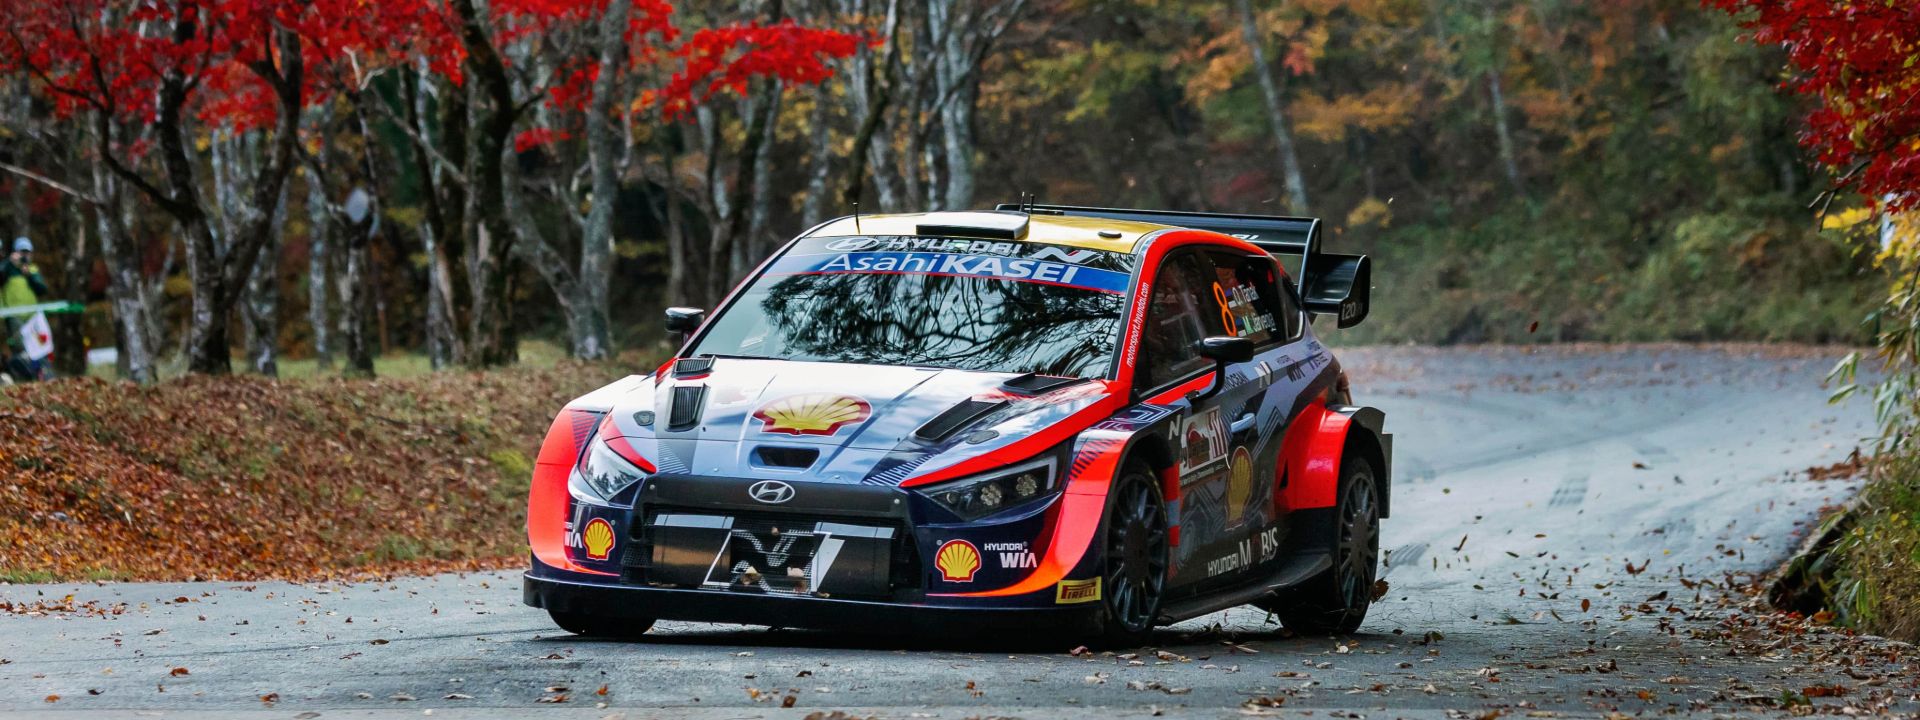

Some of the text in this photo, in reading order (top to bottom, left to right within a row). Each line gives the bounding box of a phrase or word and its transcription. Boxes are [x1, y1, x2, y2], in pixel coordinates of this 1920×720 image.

[1213, 281, 1237, 337] 8
[984, 543, 1023, 551] HYUNDAI
[1207, 527, 1279, 578] HYUNDAI MBIS
[1000, 548, 1038, 568] WIA
[1061, 582, 1096, 600] PIRELLI
